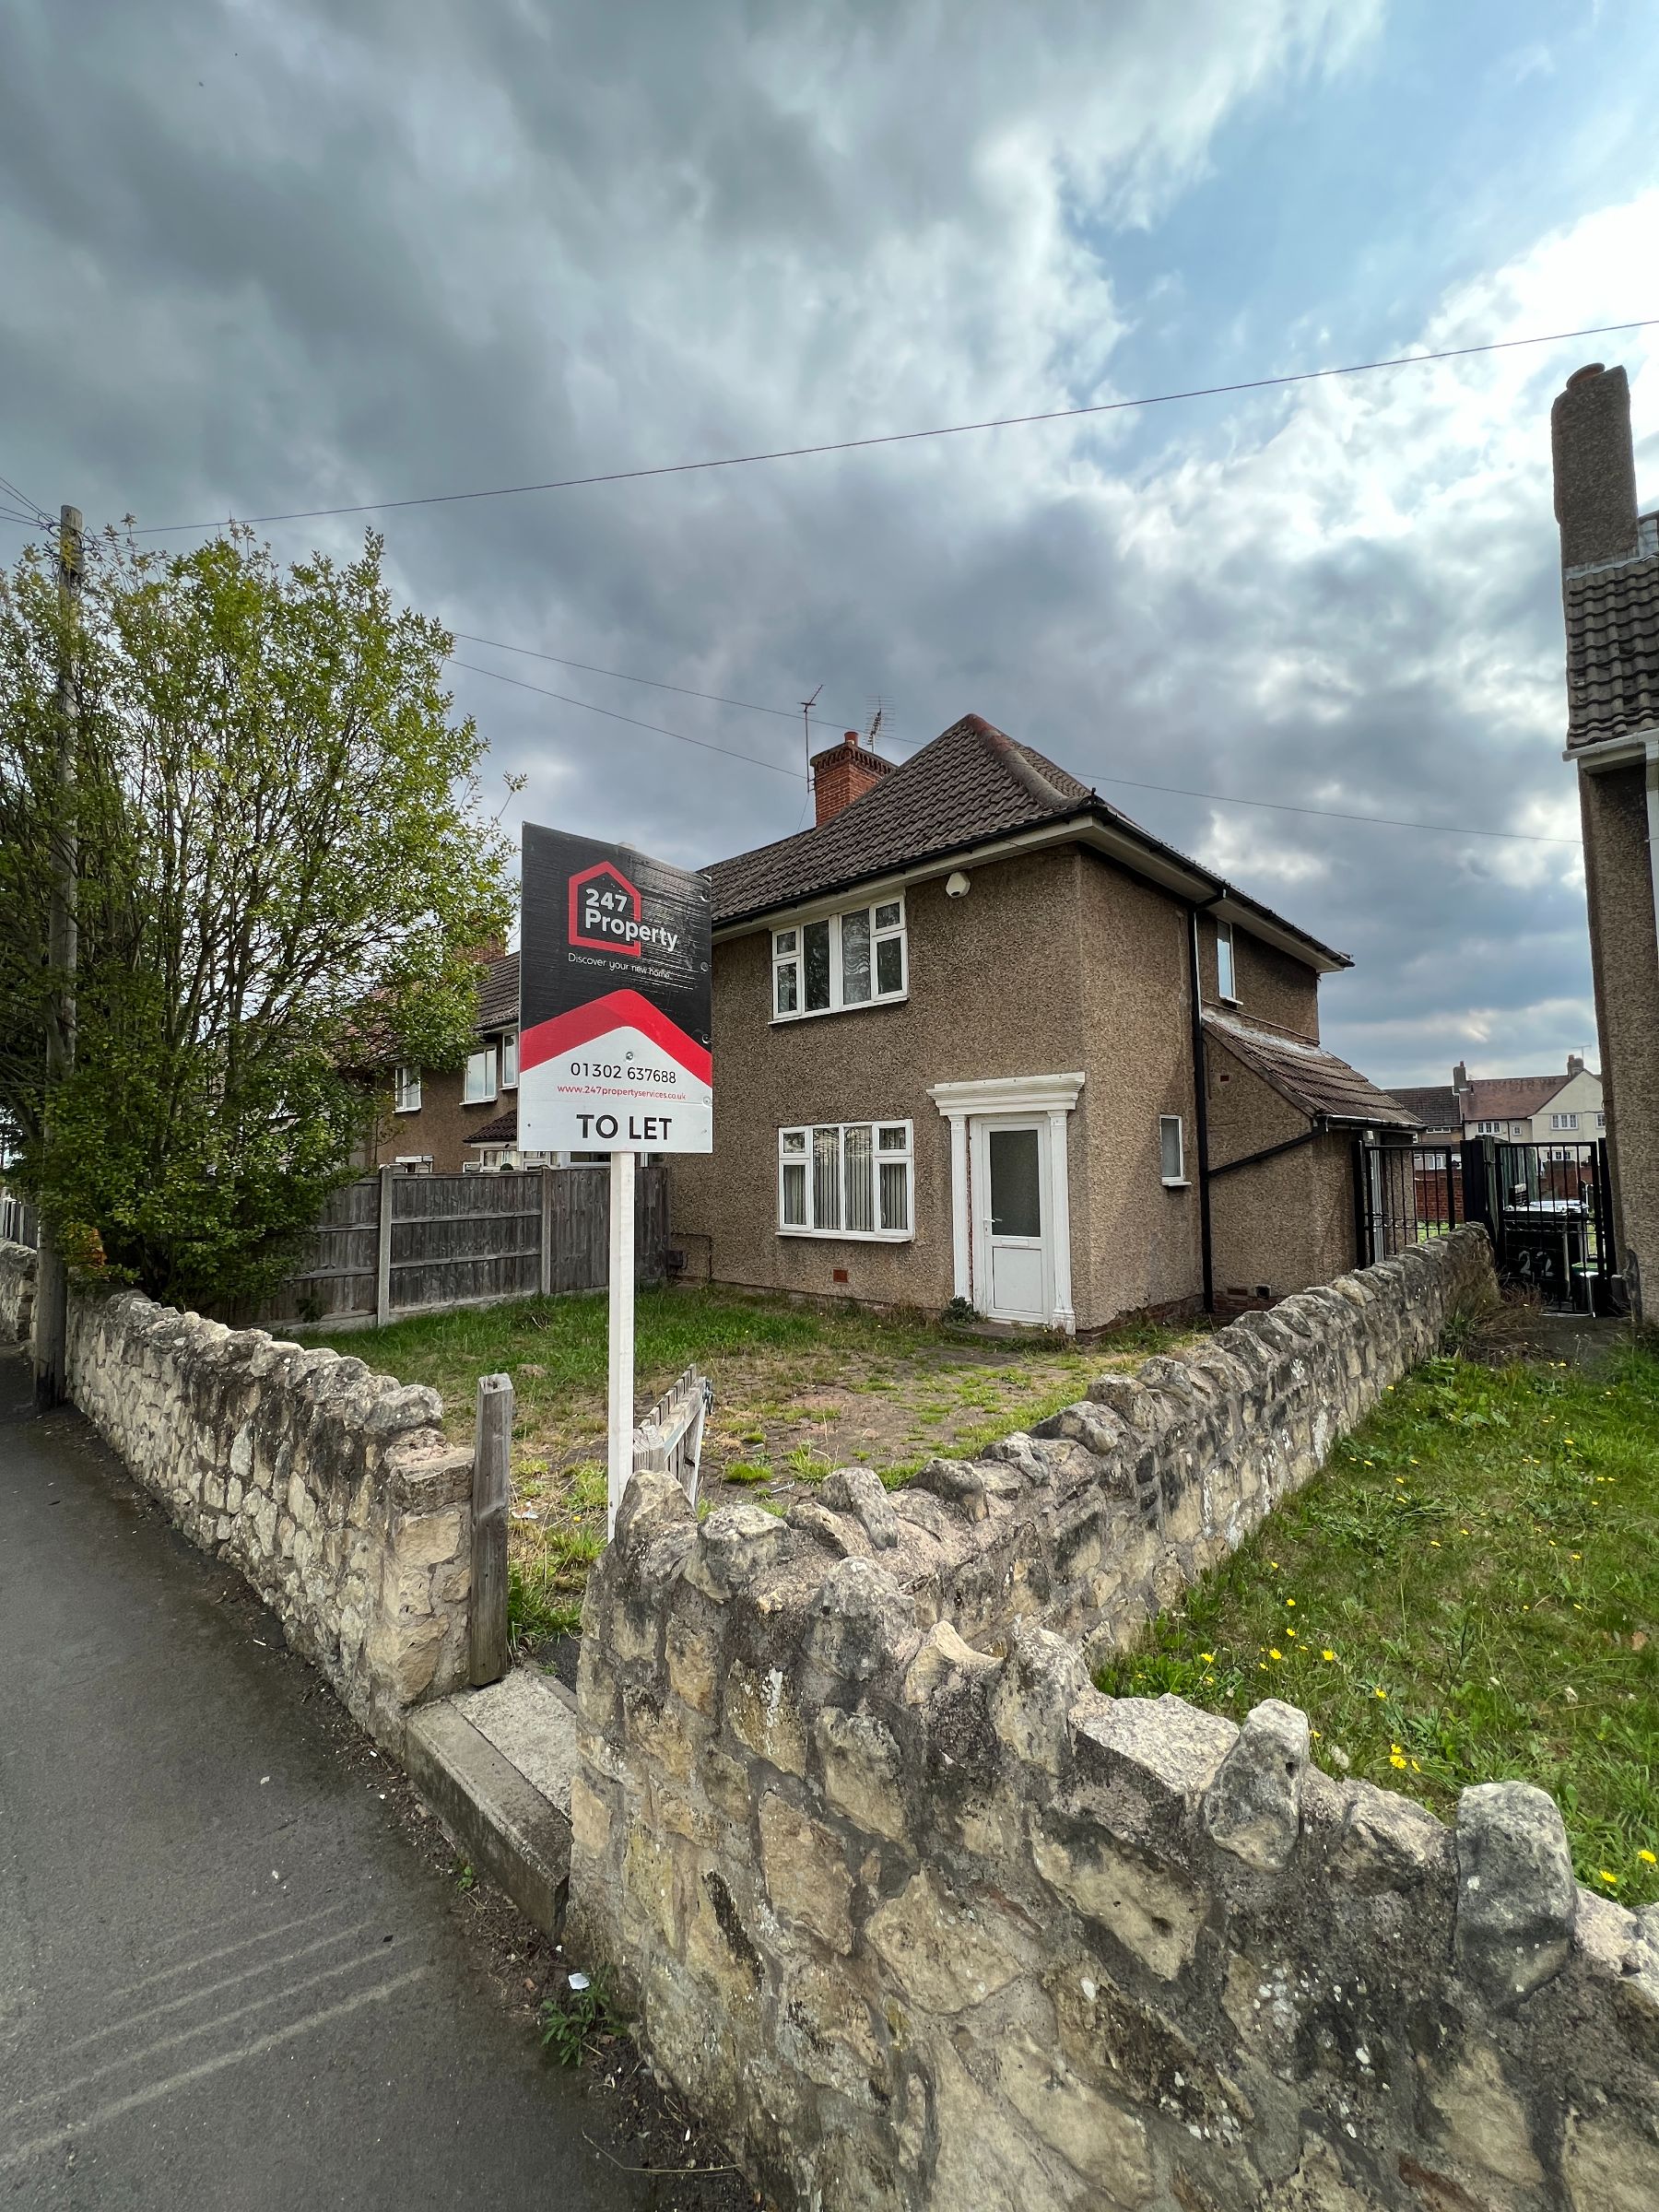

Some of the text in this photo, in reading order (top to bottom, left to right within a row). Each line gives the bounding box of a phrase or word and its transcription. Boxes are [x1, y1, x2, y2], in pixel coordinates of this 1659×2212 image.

[585, 888, 628, 912] 247
[585, 908, 678, 952] Property
[568, 952, 606, 967] Discover
[609, 960, 629, 971] your
[631, 964, 646, 974] new
[571, 1062, 677, 1084] 01302 637688
[557, 1085, 686, 1100] www.247propertyservices.co.uk
[576, 1113, 673, 1140] TO LET
